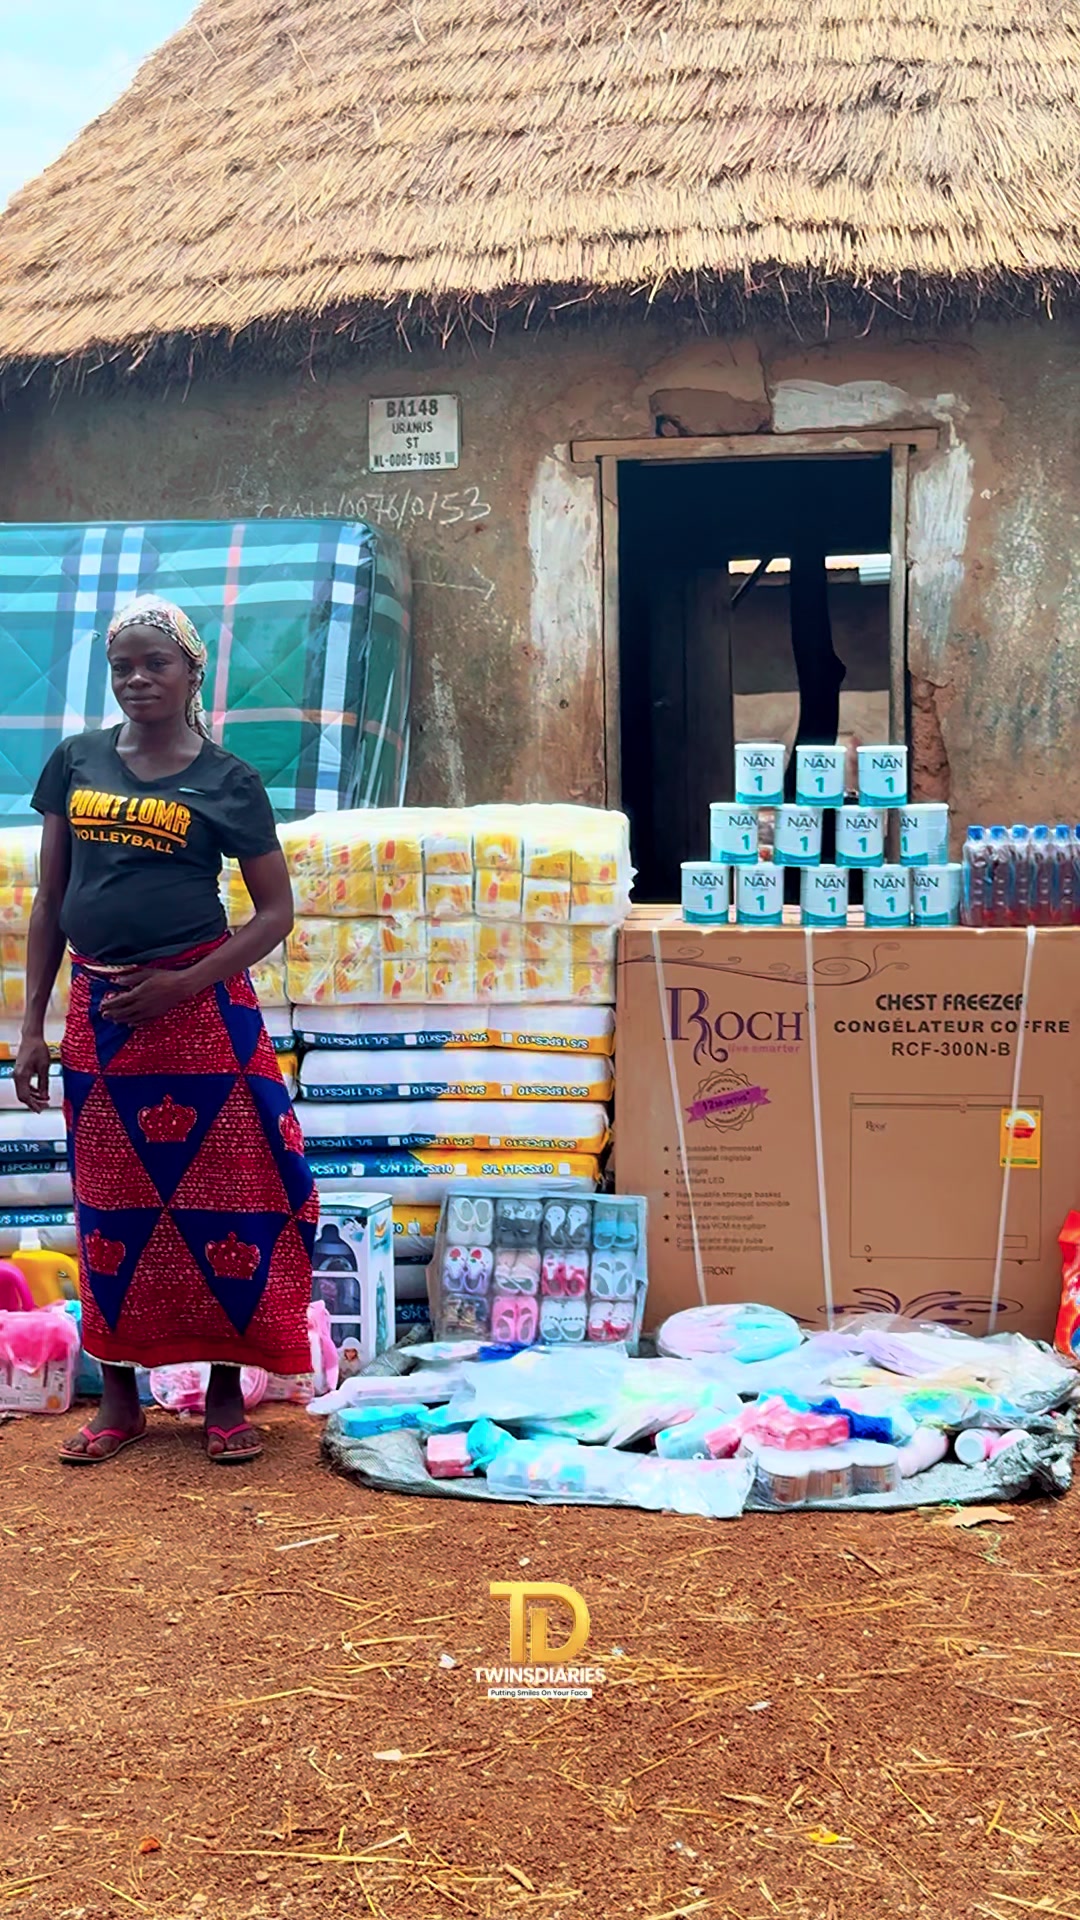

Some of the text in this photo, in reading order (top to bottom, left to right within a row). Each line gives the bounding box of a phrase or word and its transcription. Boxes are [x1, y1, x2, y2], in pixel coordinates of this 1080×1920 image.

[386, 399, 439, 418] BA148
[391, 421, 434, 434] URANUS
[405, 437, 420, 449] ST
[743, 756, 775, 768] NAN
[804, 758, 836, 769] NAN
[872, 758, 903, 769] NAN
[754, 775, 763, 792] 1
[815, 776, 824, 793] 1
[885, 776, 894, 793] 1
[70, 789, 128, 818] POINT
[787, 816, 819, 829] NAN
[846, 818, 878, 829] NAN
[75, 829, 175, 854] VOLLEYBALL
[741, 834, 750, 851] 1
[799, 836, 808, 852] 1
[858, 837, 867, 853] 1
[901, 836, 908, 852] 1
[692, 875, 724, 886] NAN
[744, 876, 776, 887] NAN
[815, 877, 846, 888] NAN
[873, 877, 905, 889] NAN
[704, 894, 713, 911] 1
[755, 895, 764, 912] 1
[827, 896, 836, 913] 1
[886, 896, 895, 913] 1
[919, 895, 927, 912] 1
[876, 994, 937, 1011] CHEST
[834, 1017, 984, 1033] CONGÉLATEUR
[372, 1036, 389, 1045] S/L
[892, 1042, 1011, 1057] RCF-300N-B
[312, 1087, 362, 1097] 11PCSx10
[365, 1087, 383, 1096] S/L
[464, 1085, 486, 1095] S/M
[569, 1087, 589, 1097] S/S
[309, 1164, 348, 1175] PCSx10
[379, 1164, 400, 1174] S/M
[403, 1164, 454, 1175] 12PCSx10
[481, 1164, 500, 1174] S/L
[14, 1213, 63, 1225] 15PCSx10
